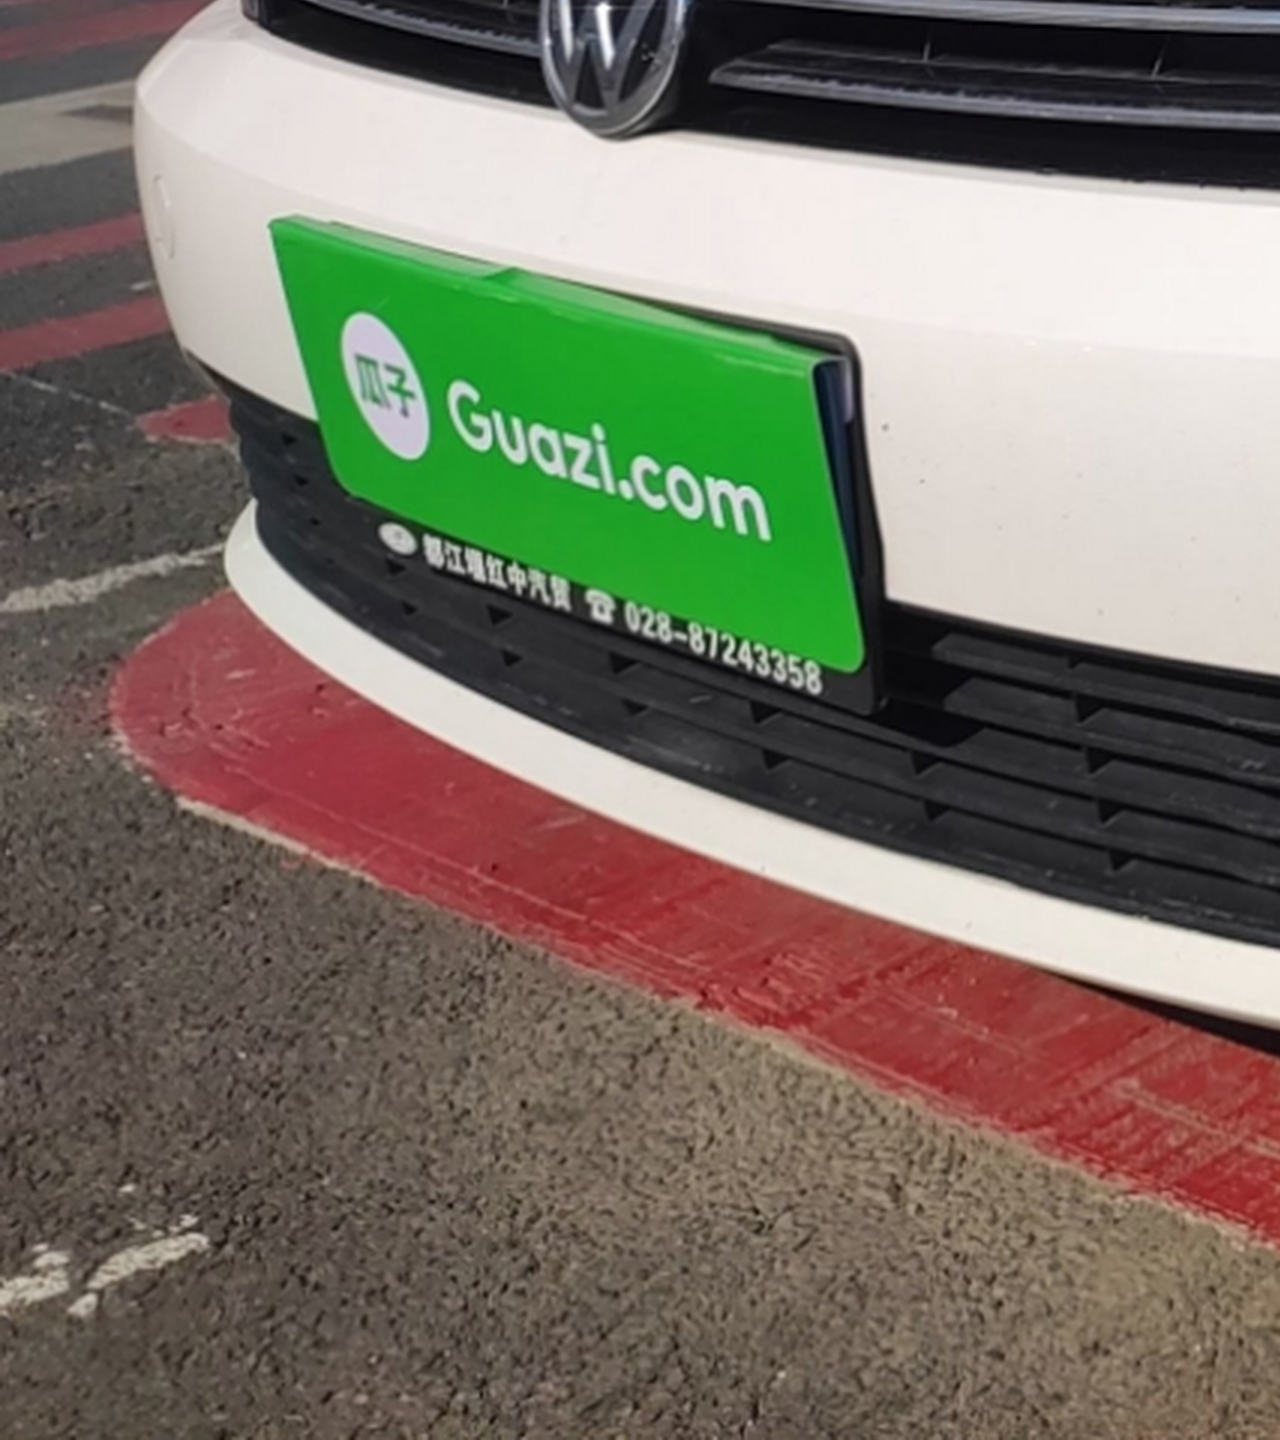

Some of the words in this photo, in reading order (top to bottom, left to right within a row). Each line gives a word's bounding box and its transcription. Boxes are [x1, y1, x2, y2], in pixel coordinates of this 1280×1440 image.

[354, 352, 416, 419] 瓜子
[447, 379, 772, 543] Guazi.com
[624, 600, 823, 696] 028-87243358
